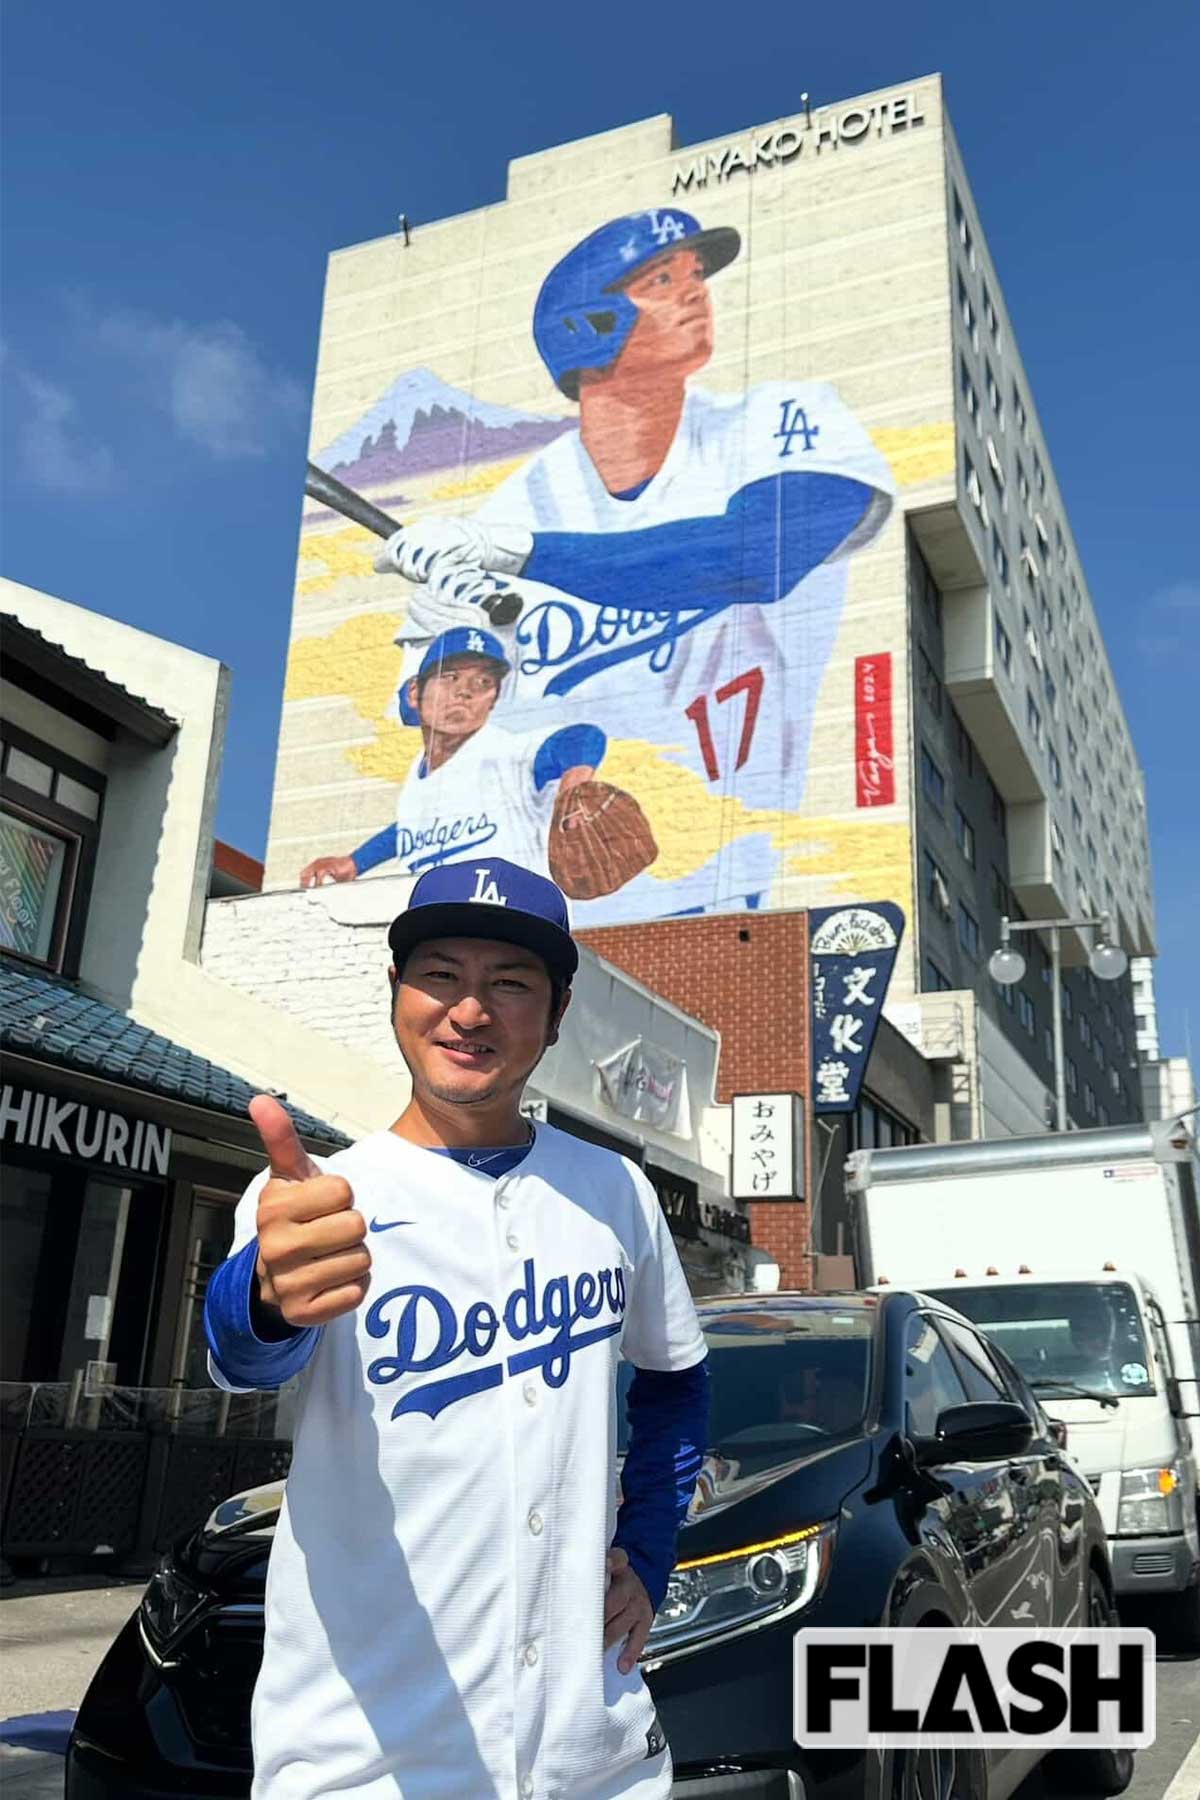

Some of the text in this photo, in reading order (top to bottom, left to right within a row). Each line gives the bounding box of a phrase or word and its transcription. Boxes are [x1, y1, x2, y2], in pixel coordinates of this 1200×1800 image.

[671, 93, 925, 196] MIYAKO HOTEL
[648, 210, 685, 244] LA
[774, 399, 819, 458] LA
[684, 666, 764, 782] 17
[397, 811, 498, 866] Dodgers
[469, 869, 507, 907] LA
[816, 966, 877, 1103] 文化堂
[0, 1084, 172, 1176] HIKURIN
[749, 1100, 778, 1191] おみやげ
